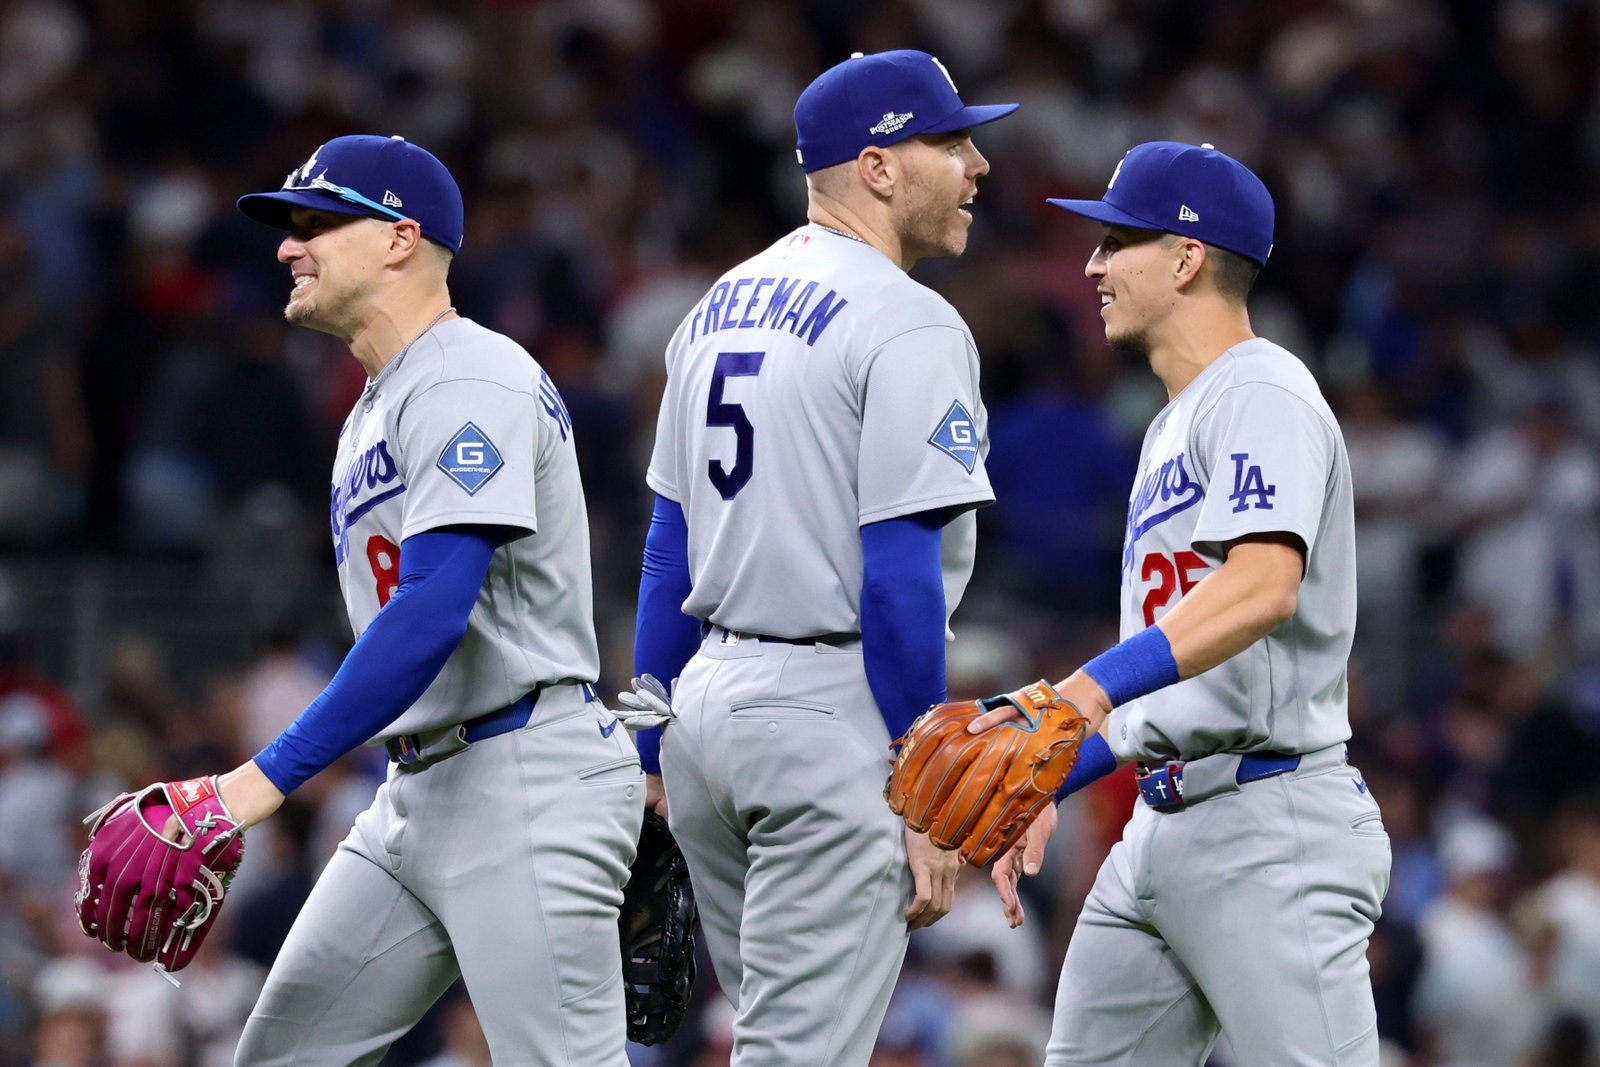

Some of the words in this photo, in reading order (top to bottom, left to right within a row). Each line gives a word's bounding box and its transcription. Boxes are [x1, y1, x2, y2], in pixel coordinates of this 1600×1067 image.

[870, 112, 914, 135] POSTSEASON
[690, 277, 848, 347] FREEMAN
[457, 442, 484, 465] G
[706, 352, 766, 500] 5
[950, 420, 971, 443] G
[1229, 453, 1276, 514] LA
[366, 535, 401, 609] 8
